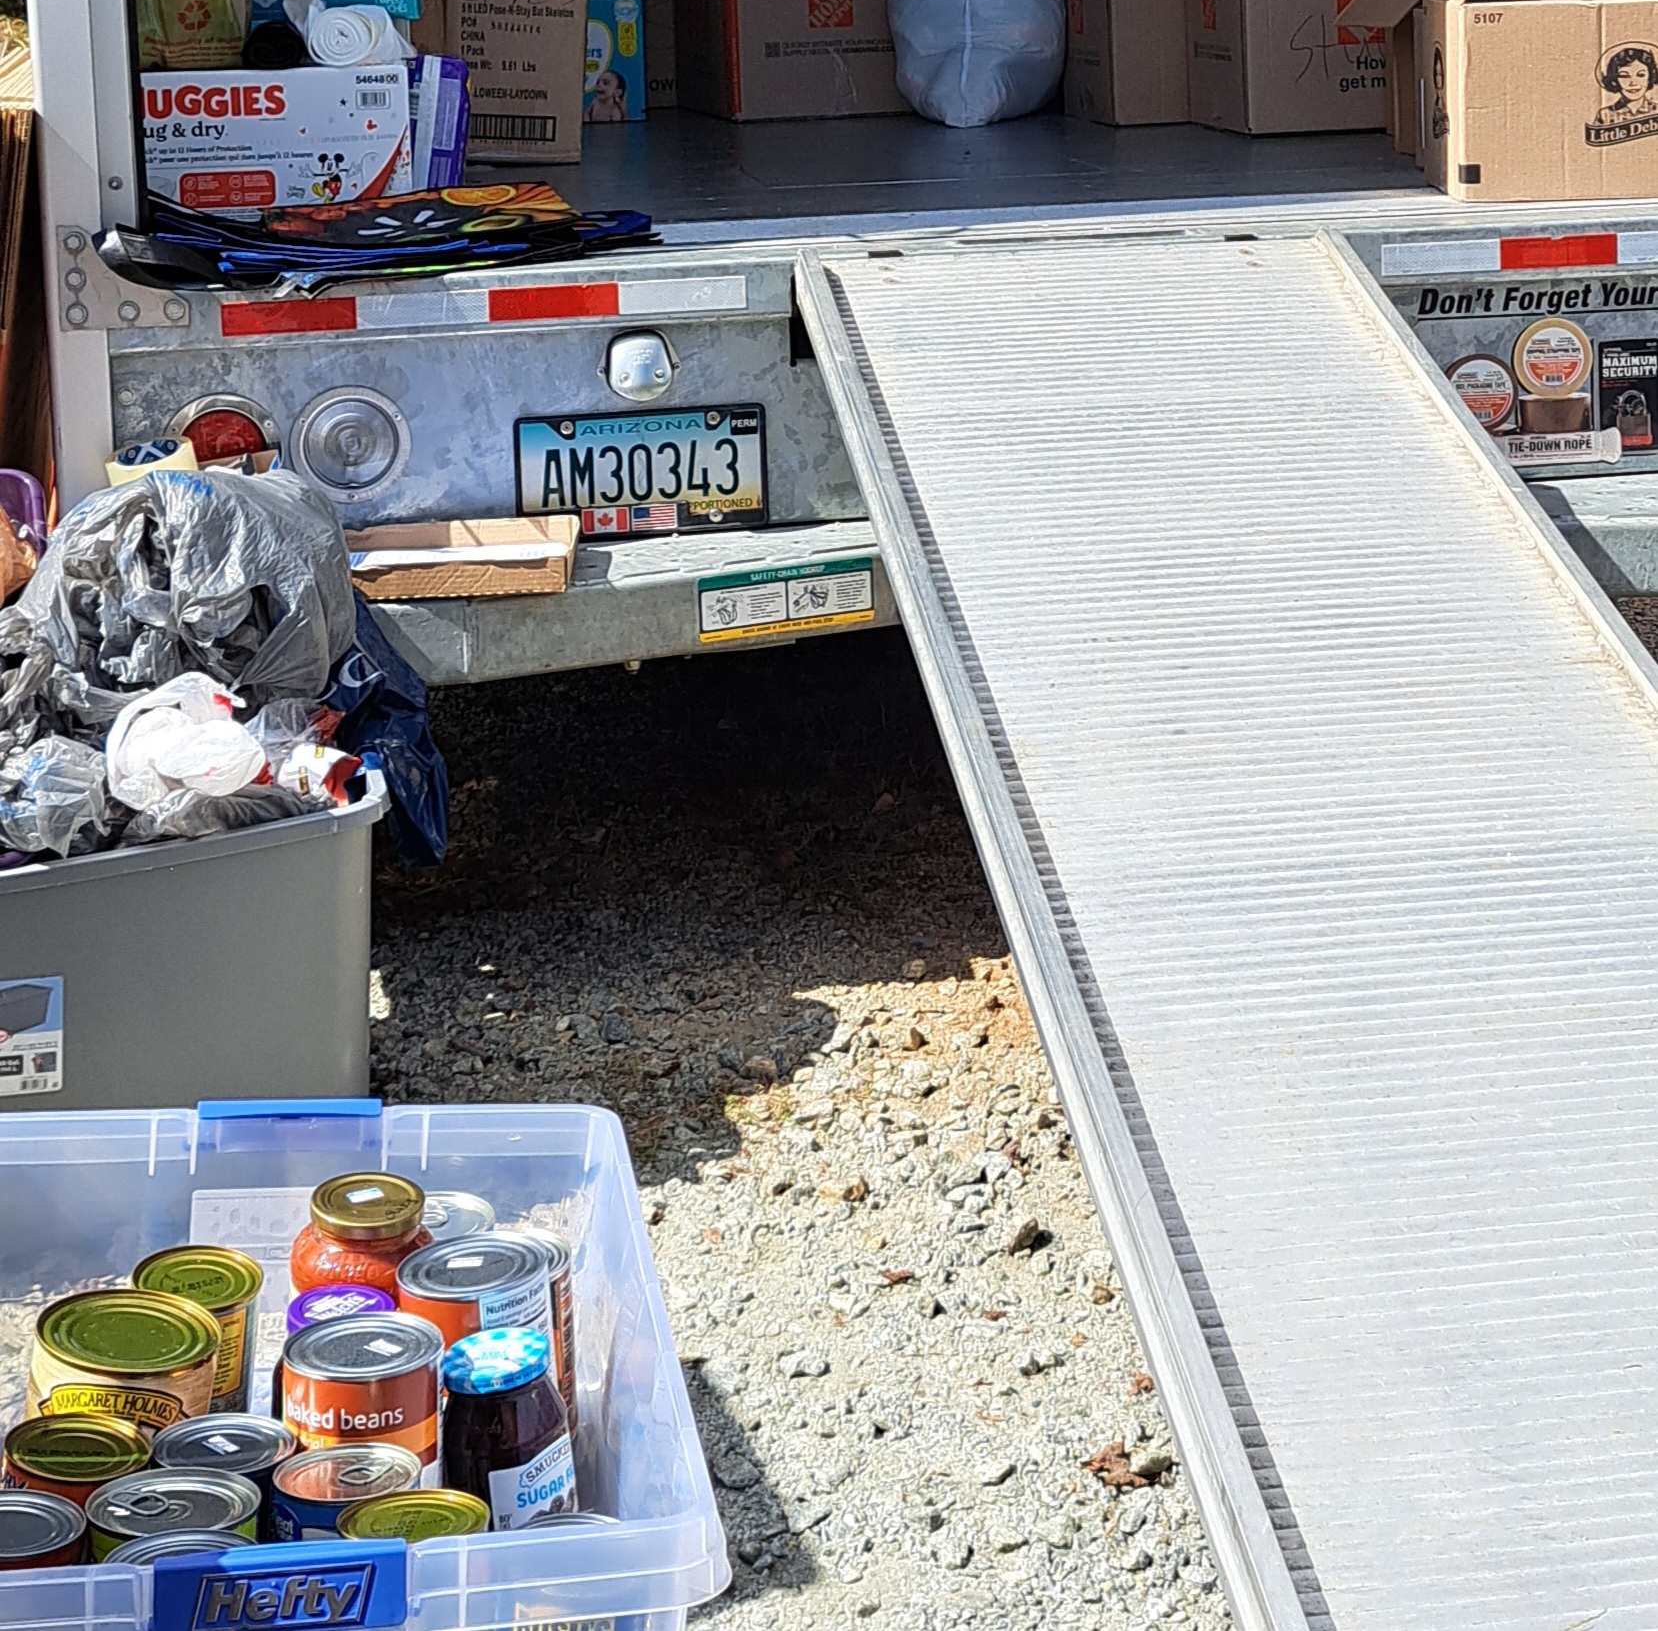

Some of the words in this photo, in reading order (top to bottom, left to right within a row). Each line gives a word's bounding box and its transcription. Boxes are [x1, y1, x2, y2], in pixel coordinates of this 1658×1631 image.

[473, 4, 488, 14] LED
[531, 7, 543, 18] Bat
[1473, 12, 1503, 24] 5107
[460, 30, 486, 42] CHINA
[466, 45, 484, 55] Pack
[522, 61, 536, 72] Lbs
[1340, 75, 1367, 92] get
[472, 86, 548, 100] LOWEEN-LAYDOWN
[144, 126, 167, 142] ug
[172, 122, 186, 138] &
[191, 121, 225, 142] dry
[1589, 127, 1627, 144] Little
[1629, 122, 1658, 137] Deb
[216, 145, 253, 153] Protection
[190, 154, 227, 164] protection
[1417, 287, 1495, 315] Don't
[1502, 282, 1592, 315] Forget
[1601, 282, 1658, 307] Your
[1602, 355, 1657, 367] MAXIMUM
[1602, 366, 1658, 378] SECURITY
[579, 418, 702, 437] ARIZONA
[730, 418, 757, 430] PERM
[1508, 439, 1561, 453] TIE-DOWN
[1564, 439, 1592, 450] ROPE
[542, 438, 739, 508] AM30343
[687, 497, 753, 511] PPORTIONED
[486, 1296, 528, 1315] Nutrition
[54, 1392, 124, 1411] MARGARET
[123, 1394, 177, 1421] HOLMES
[286, 1399, 334, 1430] baked
[340, 1405, 404, 1431] beans
[515, 1473, 565, 1508] SUGAR
[203, 1573, 361, 1625] Hefty
